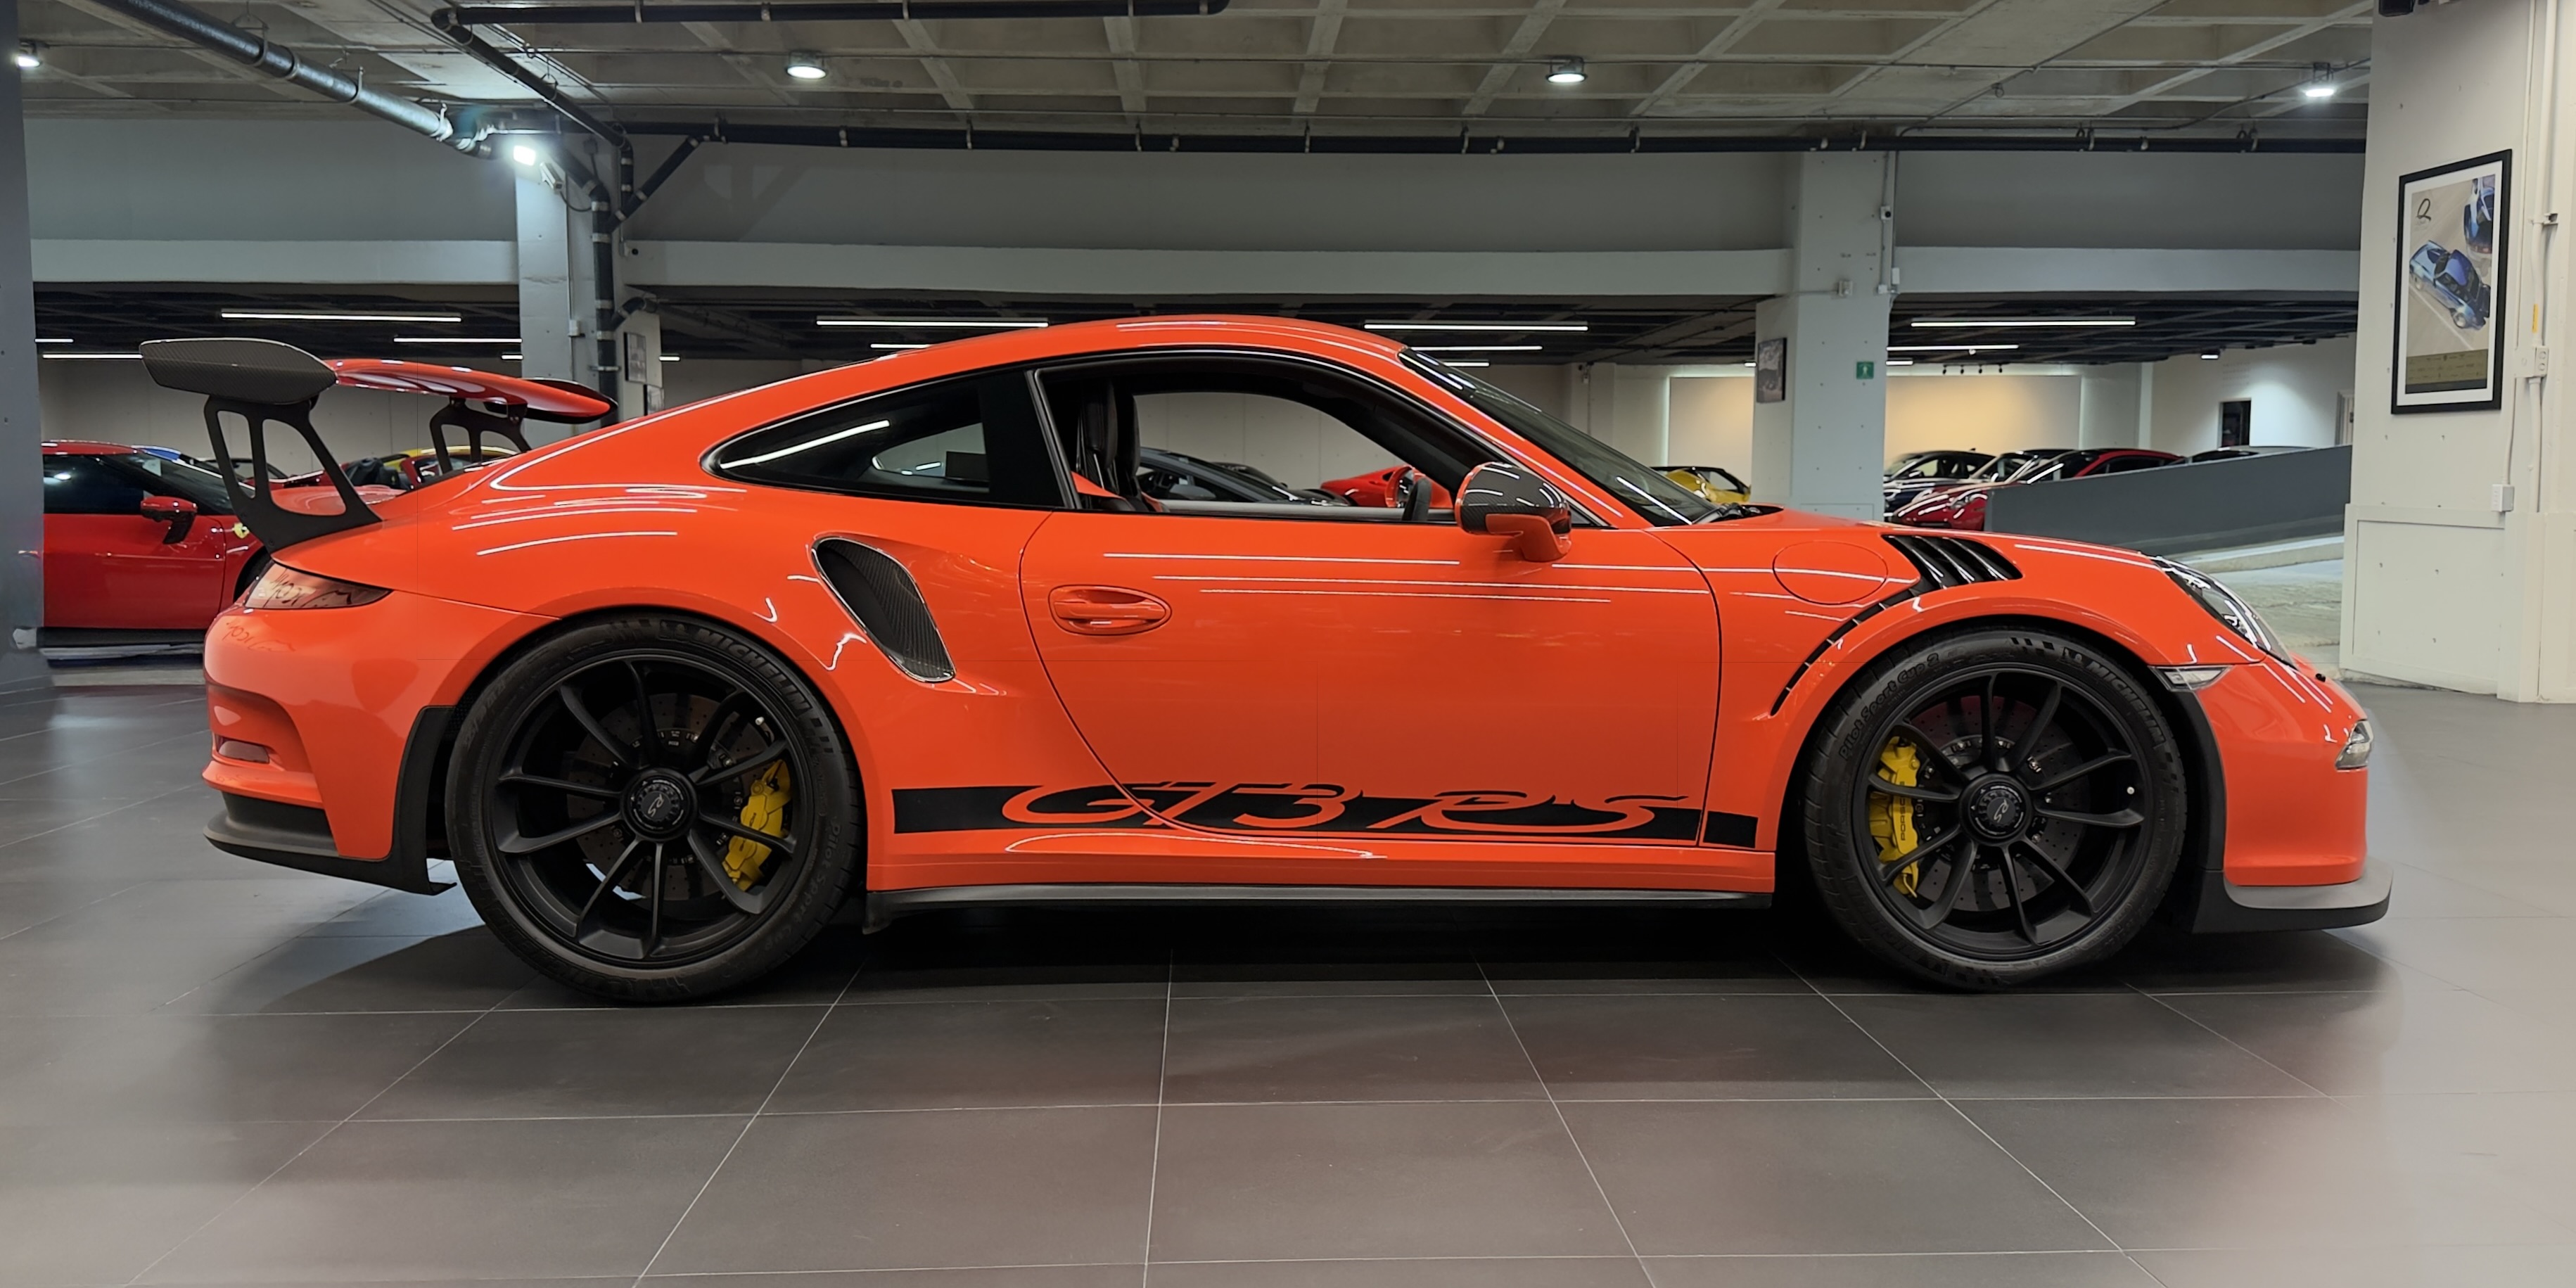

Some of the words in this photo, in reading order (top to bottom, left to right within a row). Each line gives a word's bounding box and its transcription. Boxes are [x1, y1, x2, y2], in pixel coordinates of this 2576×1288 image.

[695, 628, 811, 710] MICHELIN
[1839, 718, 1865, 761] Pilot
[1861, 680, 1897, 722] Sport
[1896, 663, 1926, 684] Cup
[1927, 652, 1939, 668] 2
[2086, 661, 2166, 744] MICHELIN
[1002, 782, 1363, 828] GT3
[1365, 790, 1689, 833] RS
